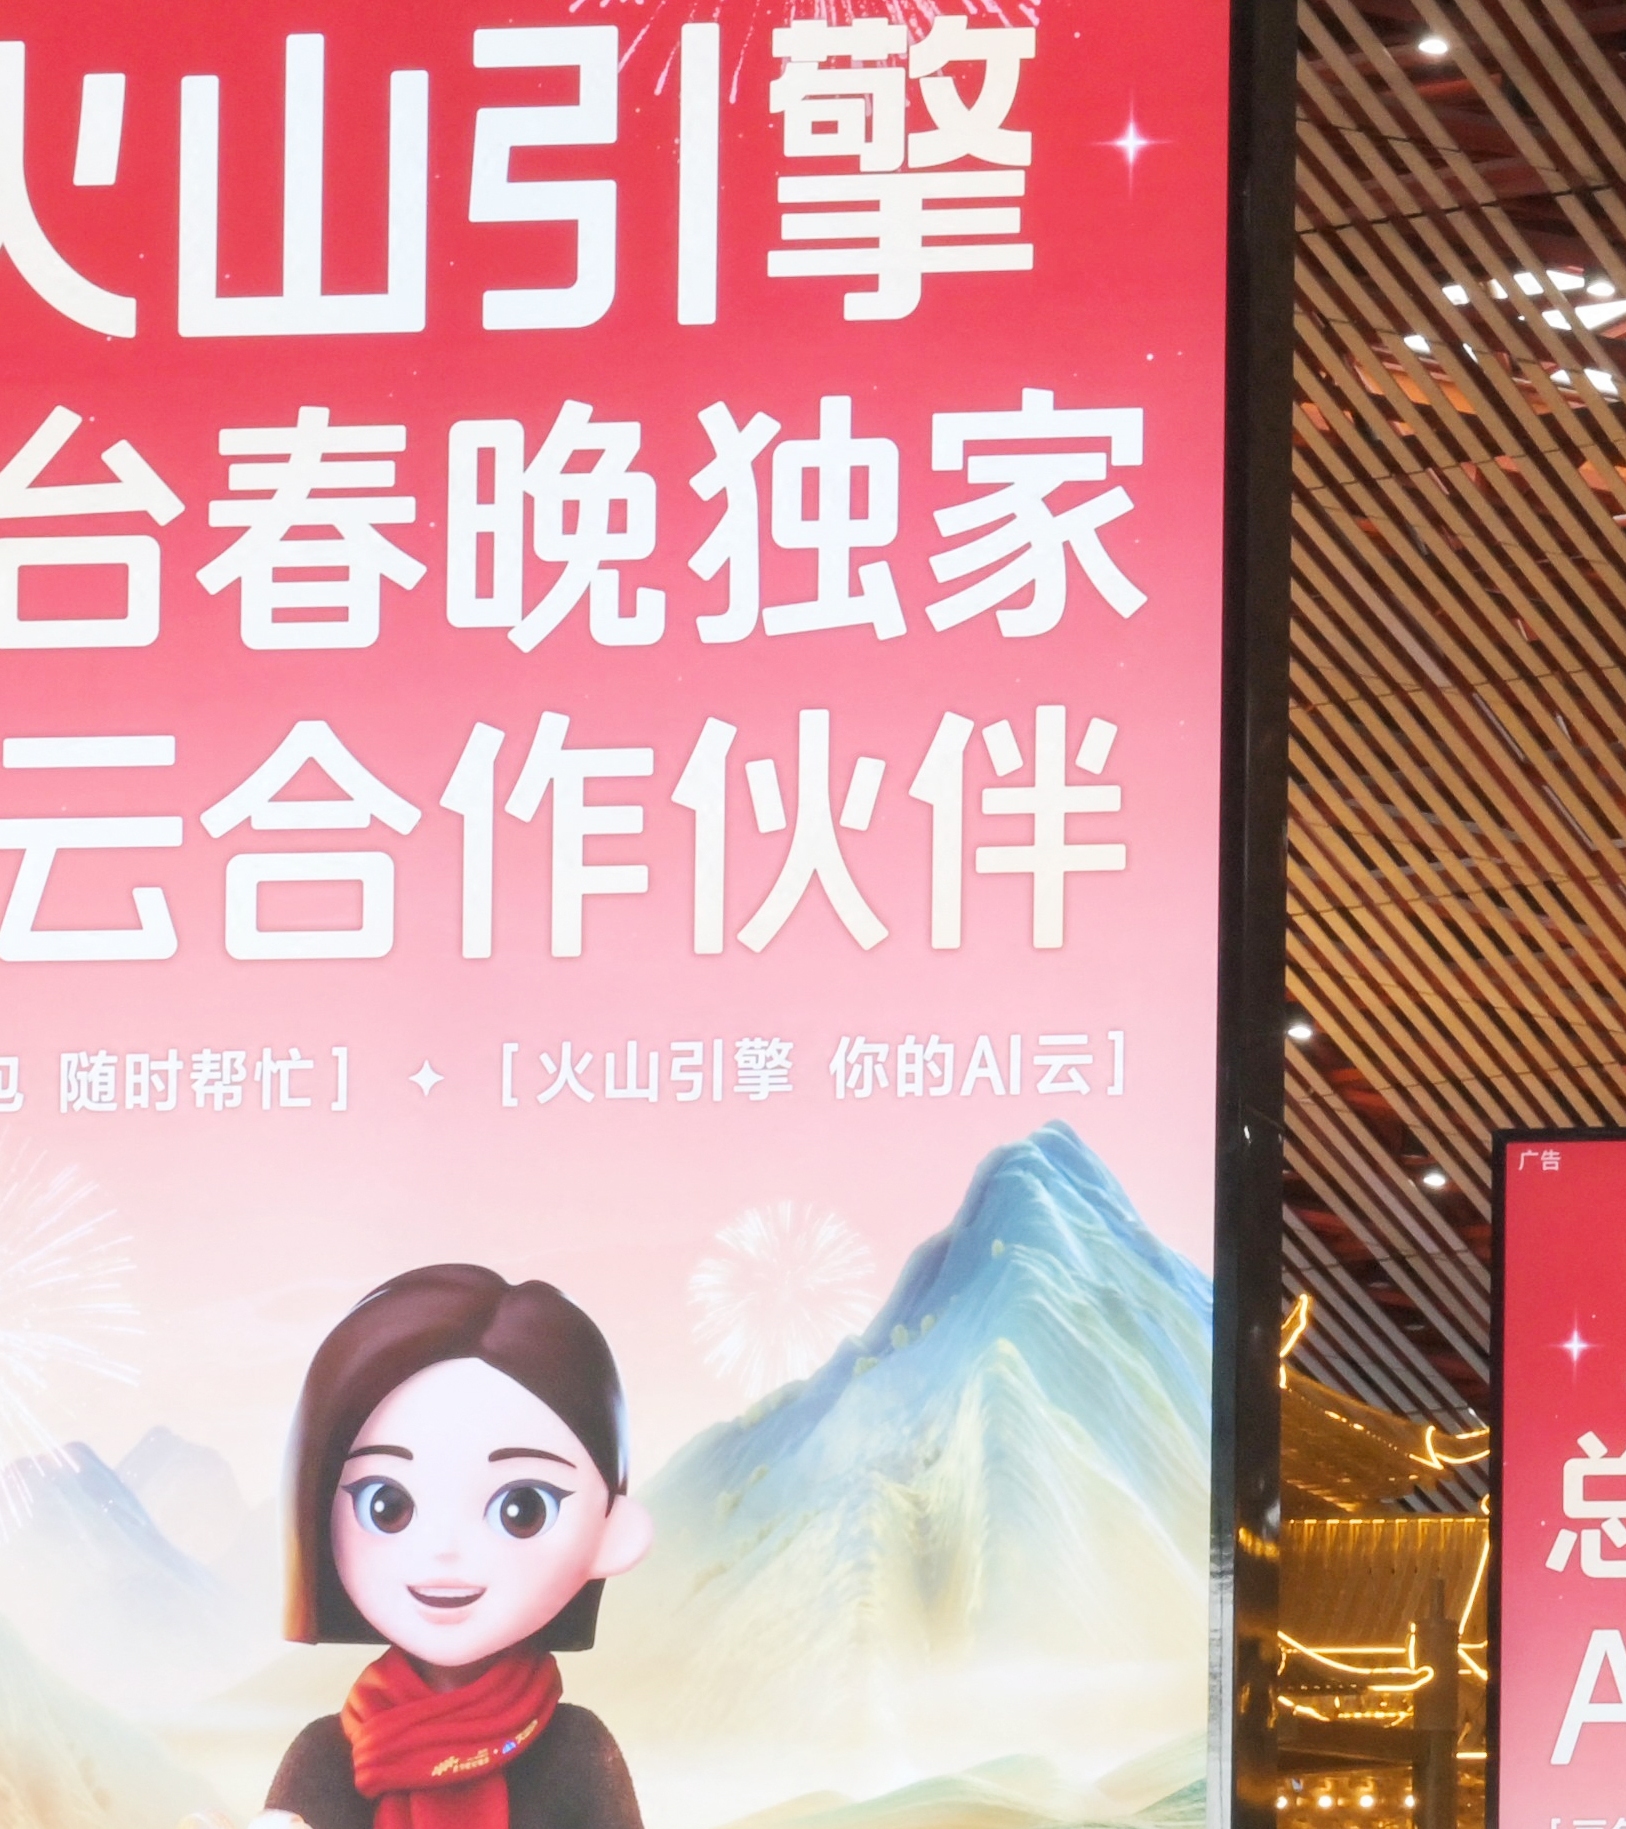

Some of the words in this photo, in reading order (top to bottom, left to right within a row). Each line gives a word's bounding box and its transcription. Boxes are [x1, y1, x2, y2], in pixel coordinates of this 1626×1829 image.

[0, 388, 1148, 653] 台春晚独家
[0, 706, 1126, 962] 云合作伙伴
[1519, 1150, 1560, 1170] 广告
